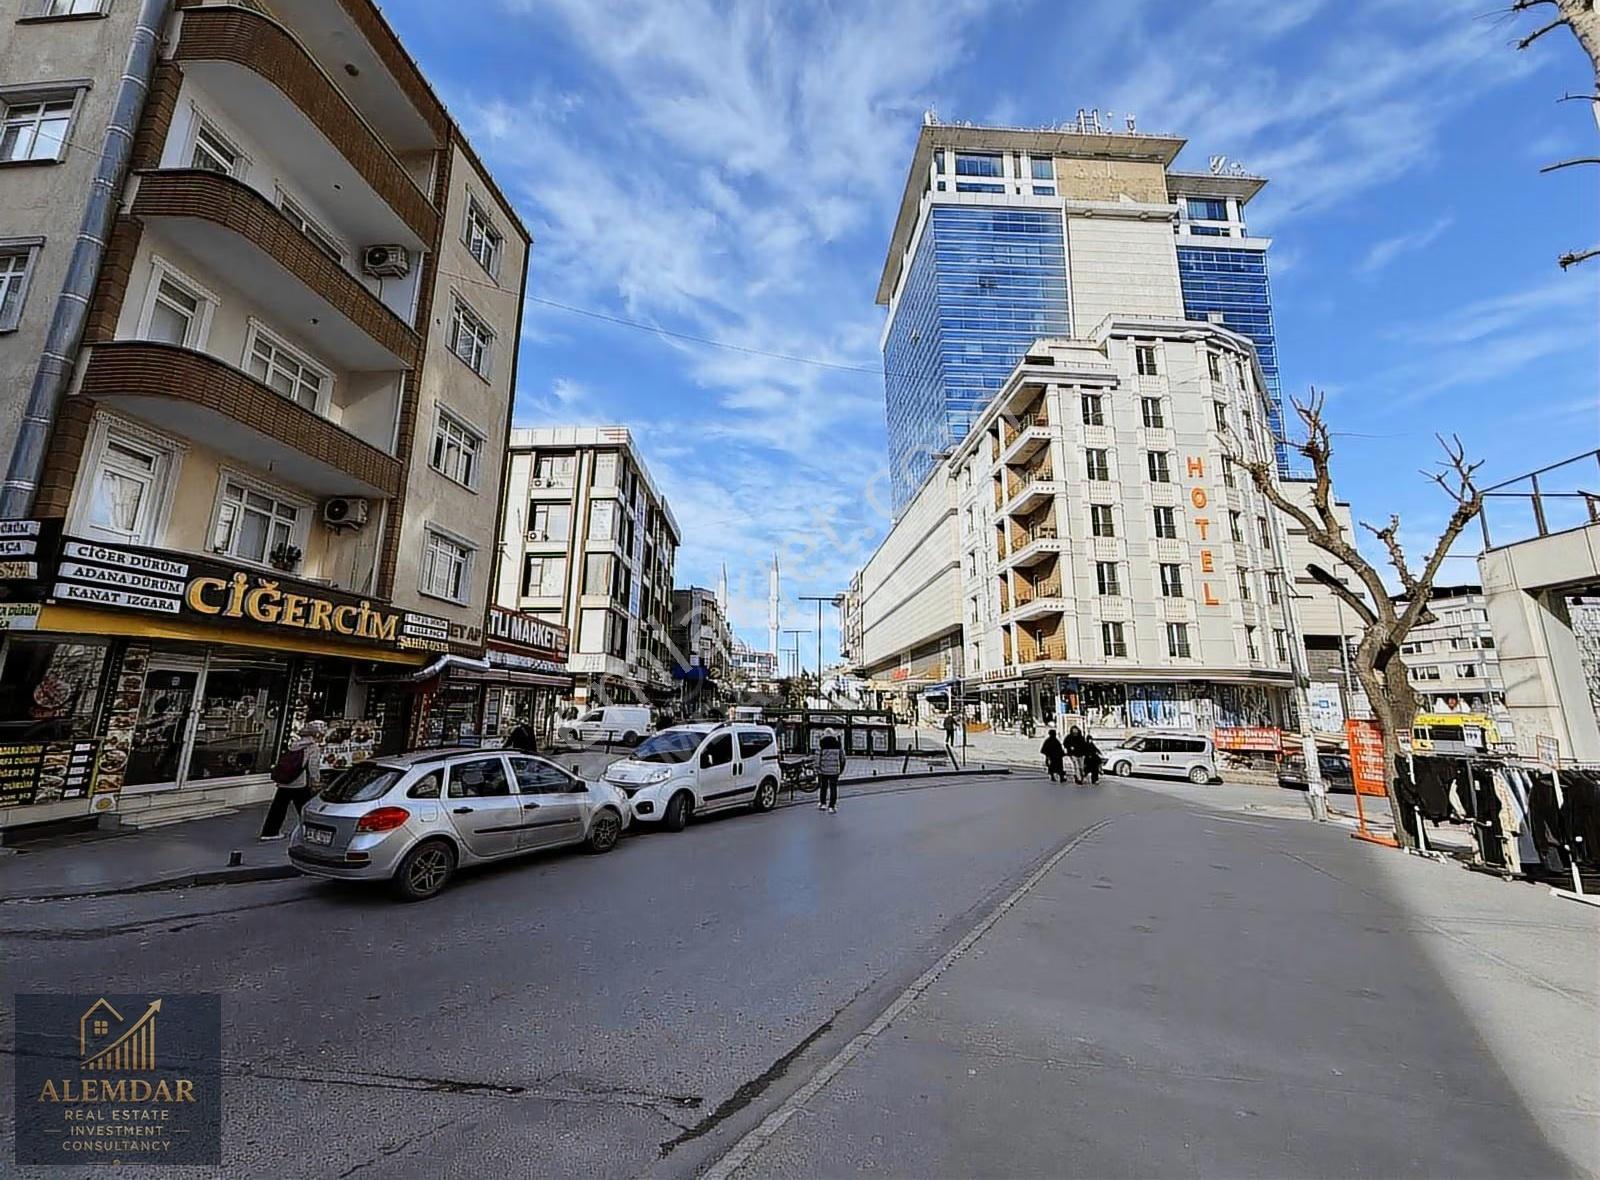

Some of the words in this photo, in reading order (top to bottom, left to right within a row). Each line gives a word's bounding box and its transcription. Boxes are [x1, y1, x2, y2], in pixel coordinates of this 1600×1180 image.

[1186, 456, 1220, 605] HOTEL
[73, 566, 128, 584] ADANA
[130, 575, 180, 592] DÜRÜM
[130, 555, 182, 574] DÜRÜM
[67, 586, 121, 602] KANAT
[127, 594, 174, 610] IZGARA
[185, 571, 399, 641] CİĞERCİM
[511, 615, 557, 650] MARKET
